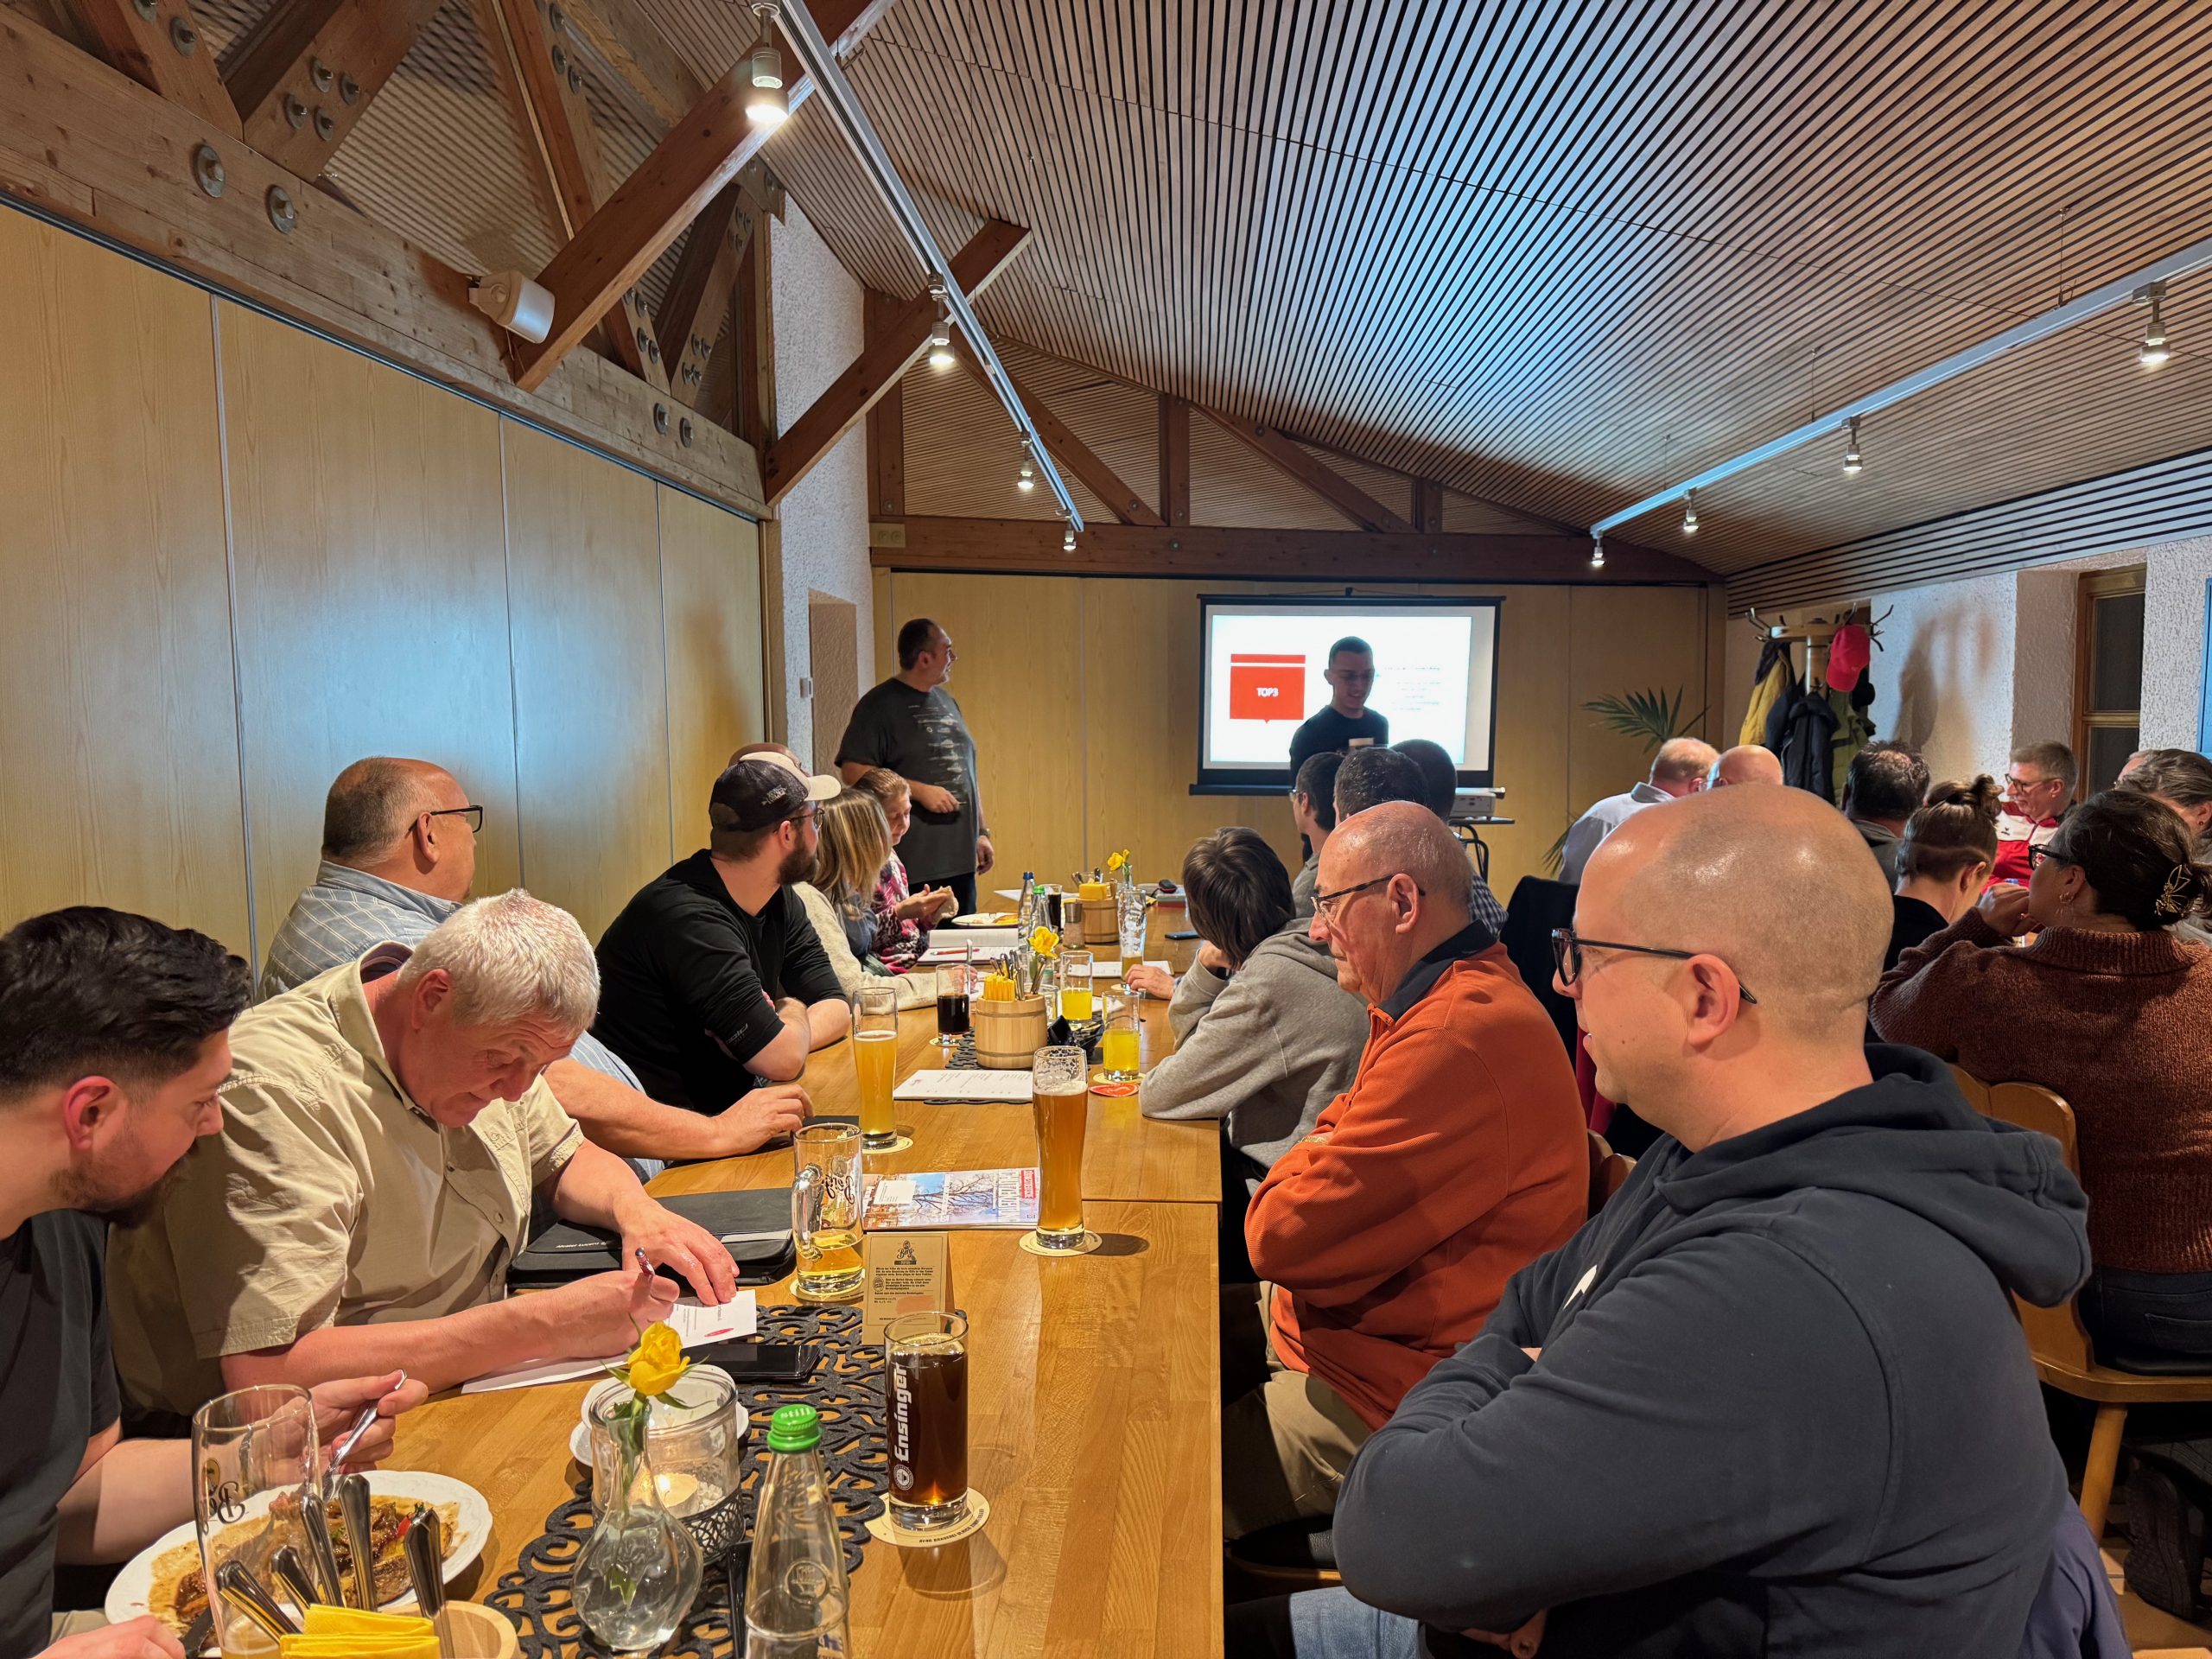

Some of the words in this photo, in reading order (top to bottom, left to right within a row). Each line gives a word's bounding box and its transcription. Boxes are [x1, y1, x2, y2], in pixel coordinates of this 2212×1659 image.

[897, 1248, 915, 1259] Berg
[780, 1408, 810, 1418] still
[893, 1362, 912, 1462] Ensinger
